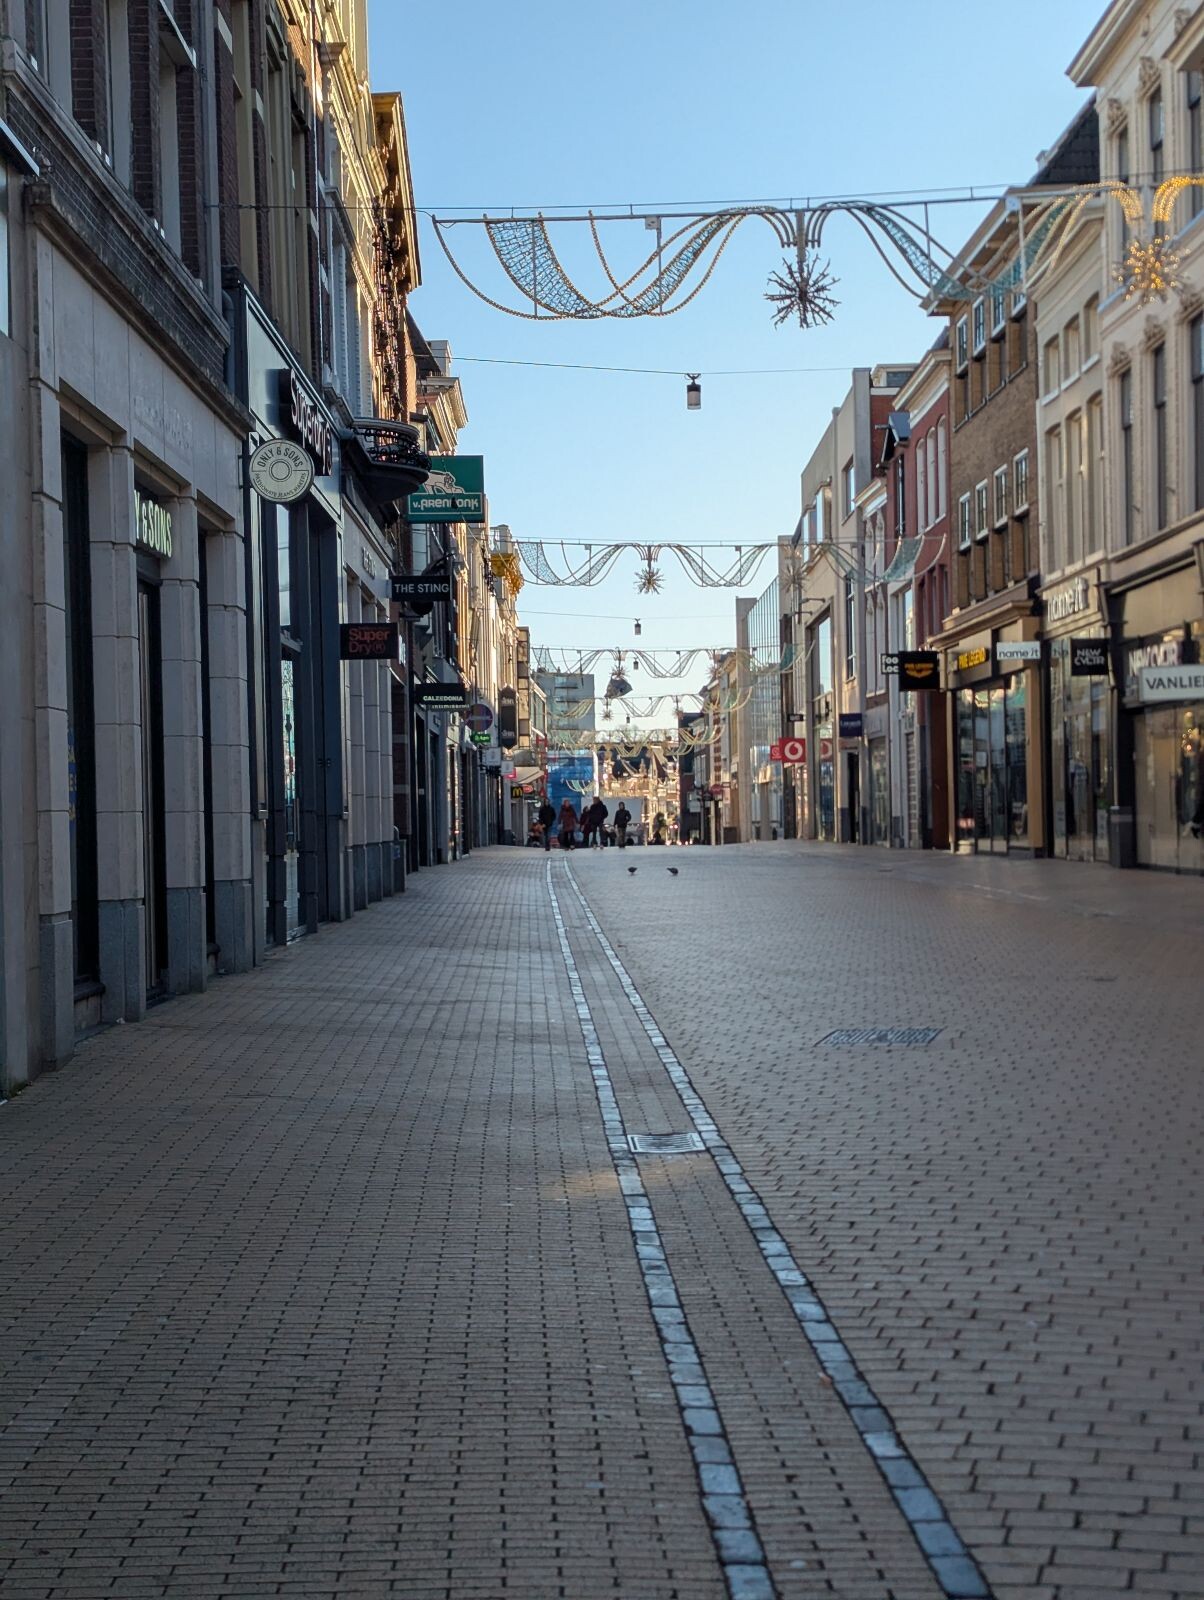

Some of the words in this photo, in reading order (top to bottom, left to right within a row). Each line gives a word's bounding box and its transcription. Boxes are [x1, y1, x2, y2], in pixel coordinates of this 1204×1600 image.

[257, 448, 274, 467] ONLY
[284, 447, 303, 467] SONS
[148, 499, 172, 558] SONS
[394, 583, 415, 593] THE
[417, 583, 450, 593] STING
[349, 628, 391, 643] Super
[882, 655, 899, 664] Foo
[998, 649, 1029, 659] name
[1145, 674, 1204, 690] VANLIE
